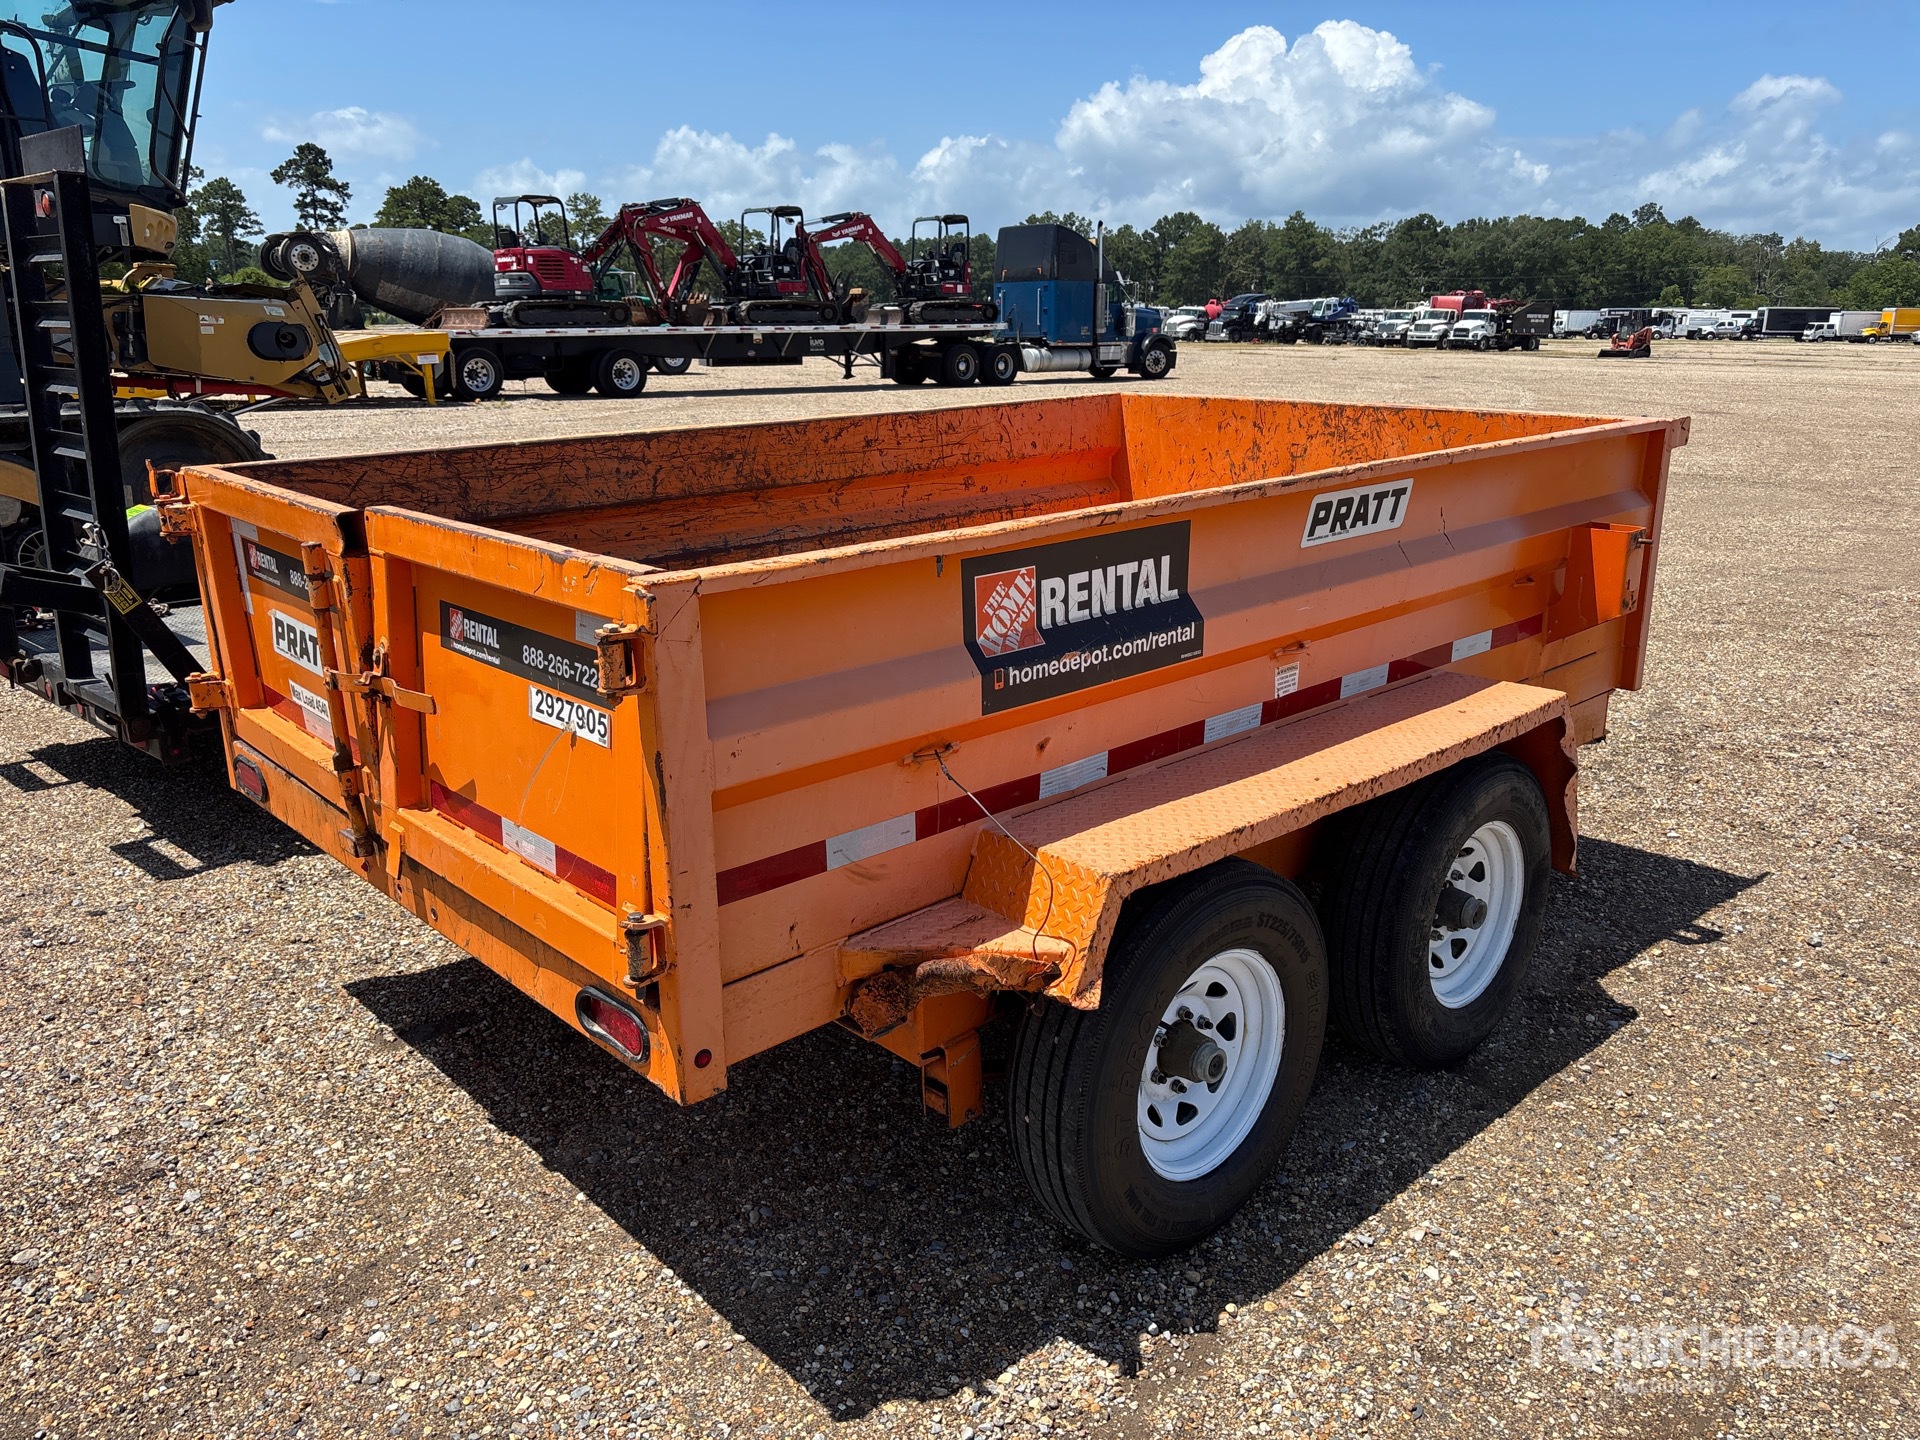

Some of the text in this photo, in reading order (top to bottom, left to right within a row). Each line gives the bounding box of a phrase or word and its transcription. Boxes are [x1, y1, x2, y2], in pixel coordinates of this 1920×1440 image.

[669, 211, 694, 222] YANMAR
[841, 223, 865, 235] YANMAR
[1307, 486, 1408, 538] PRATT
[256, 551, 279, 574] RENTAL
[978, 568, 1035, 655] HOME
[982, 580, 1009, 617] THE
[1041, 555, 1180, 630] RENTAL
[274, 616, 320, 667] PRAT
[463, 618, 500, 650] RENTAL
[1005, 597, 1036, 651] DEPOT
[522, 644, 598, 689] 888-266-722
[1009, 621, 1196, 686] homedepot.com/rental
[301, 689, 316, 710] Load
[535, 689, 608, 739] 2927905
[1256, 910, 1312, 966] ST225/75R15
